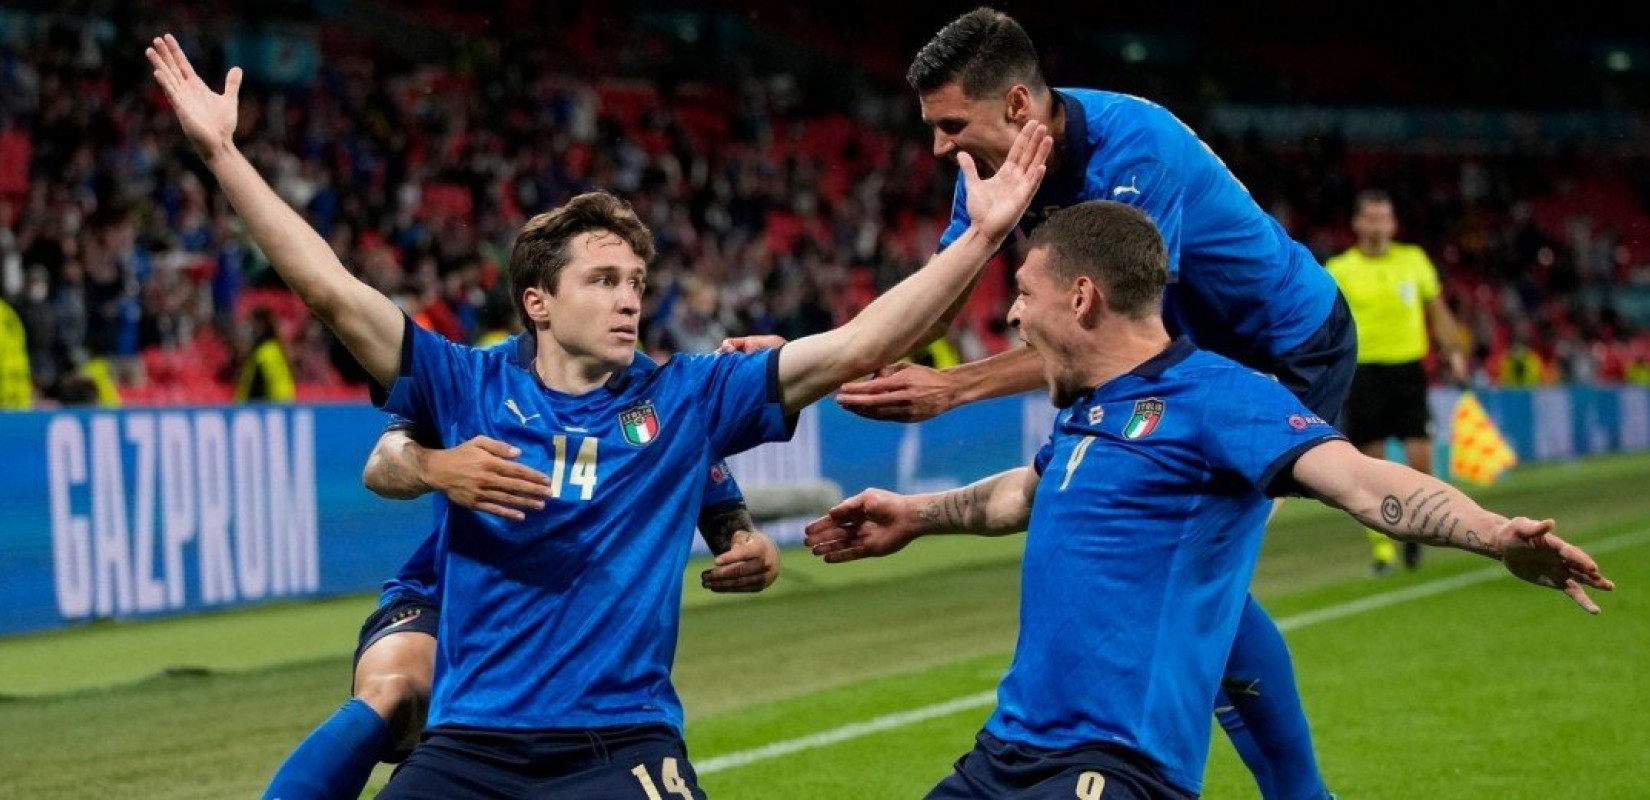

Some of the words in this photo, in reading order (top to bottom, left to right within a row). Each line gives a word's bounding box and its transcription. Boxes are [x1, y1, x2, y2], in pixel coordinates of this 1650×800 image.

[551, 435, 598, 500] 14
[1059, 435, 1096, 491] 9
[47, 409, 319, 618] GAZPROM
[631, 757, 694, 800] 14
[1076, 771, 1105, 800] 9
